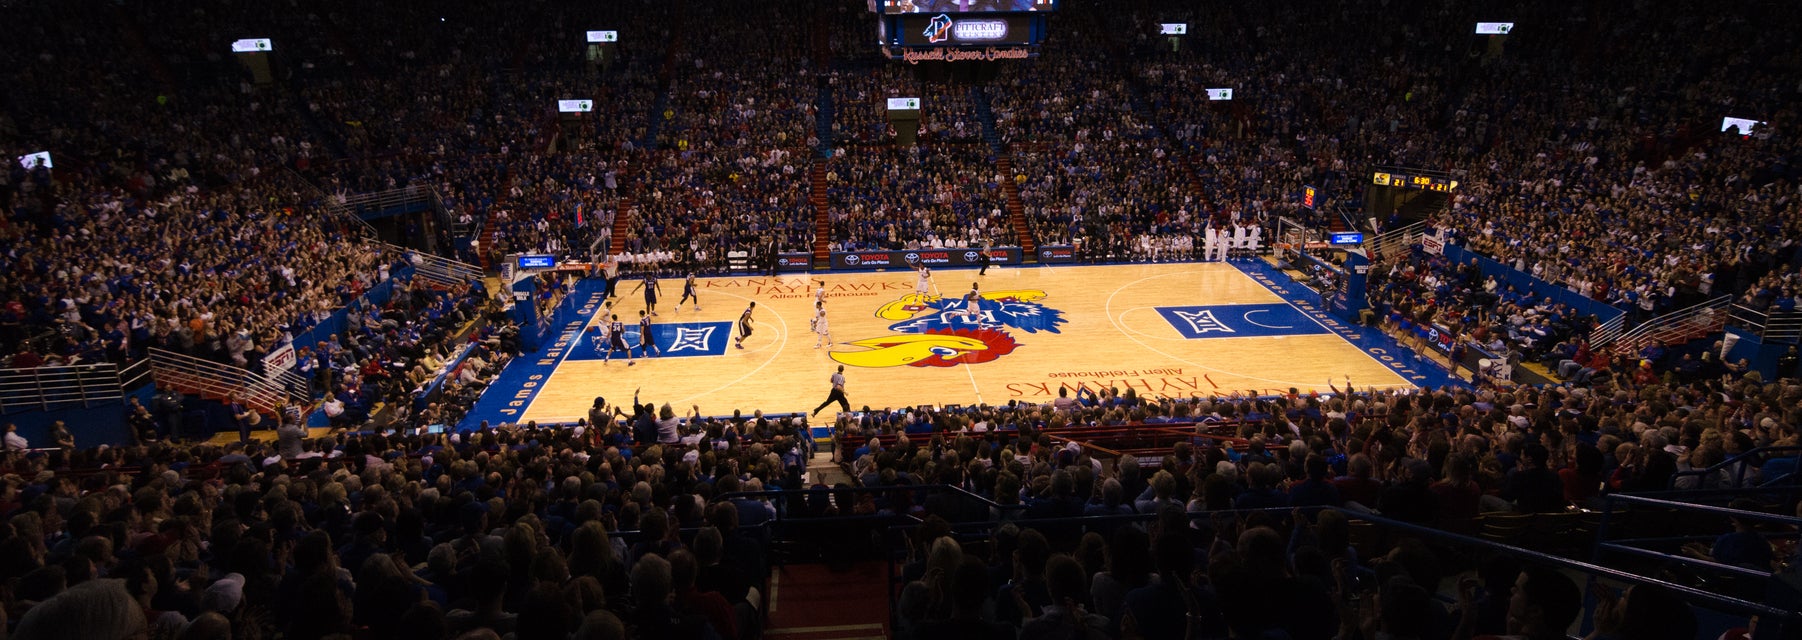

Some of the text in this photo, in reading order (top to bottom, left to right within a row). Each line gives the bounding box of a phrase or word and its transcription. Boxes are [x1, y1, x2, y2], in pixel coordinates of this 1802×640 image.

[956, 23, 1003, 31] PITTCRAFT
[903, 47, 1029, 64] Russell Stover Candies
[1414, 176, 1430, 185] 6:30
[1423, 237, 1443, 252] ESPN
[706, 278, 823, 288] KANSAS
[1249, 271, 1428, 381] James Naismith Court
[499, 291, 605, 416] James Naismith Court
[1048, 368, 1183, 379] Allen Fieldhouse
